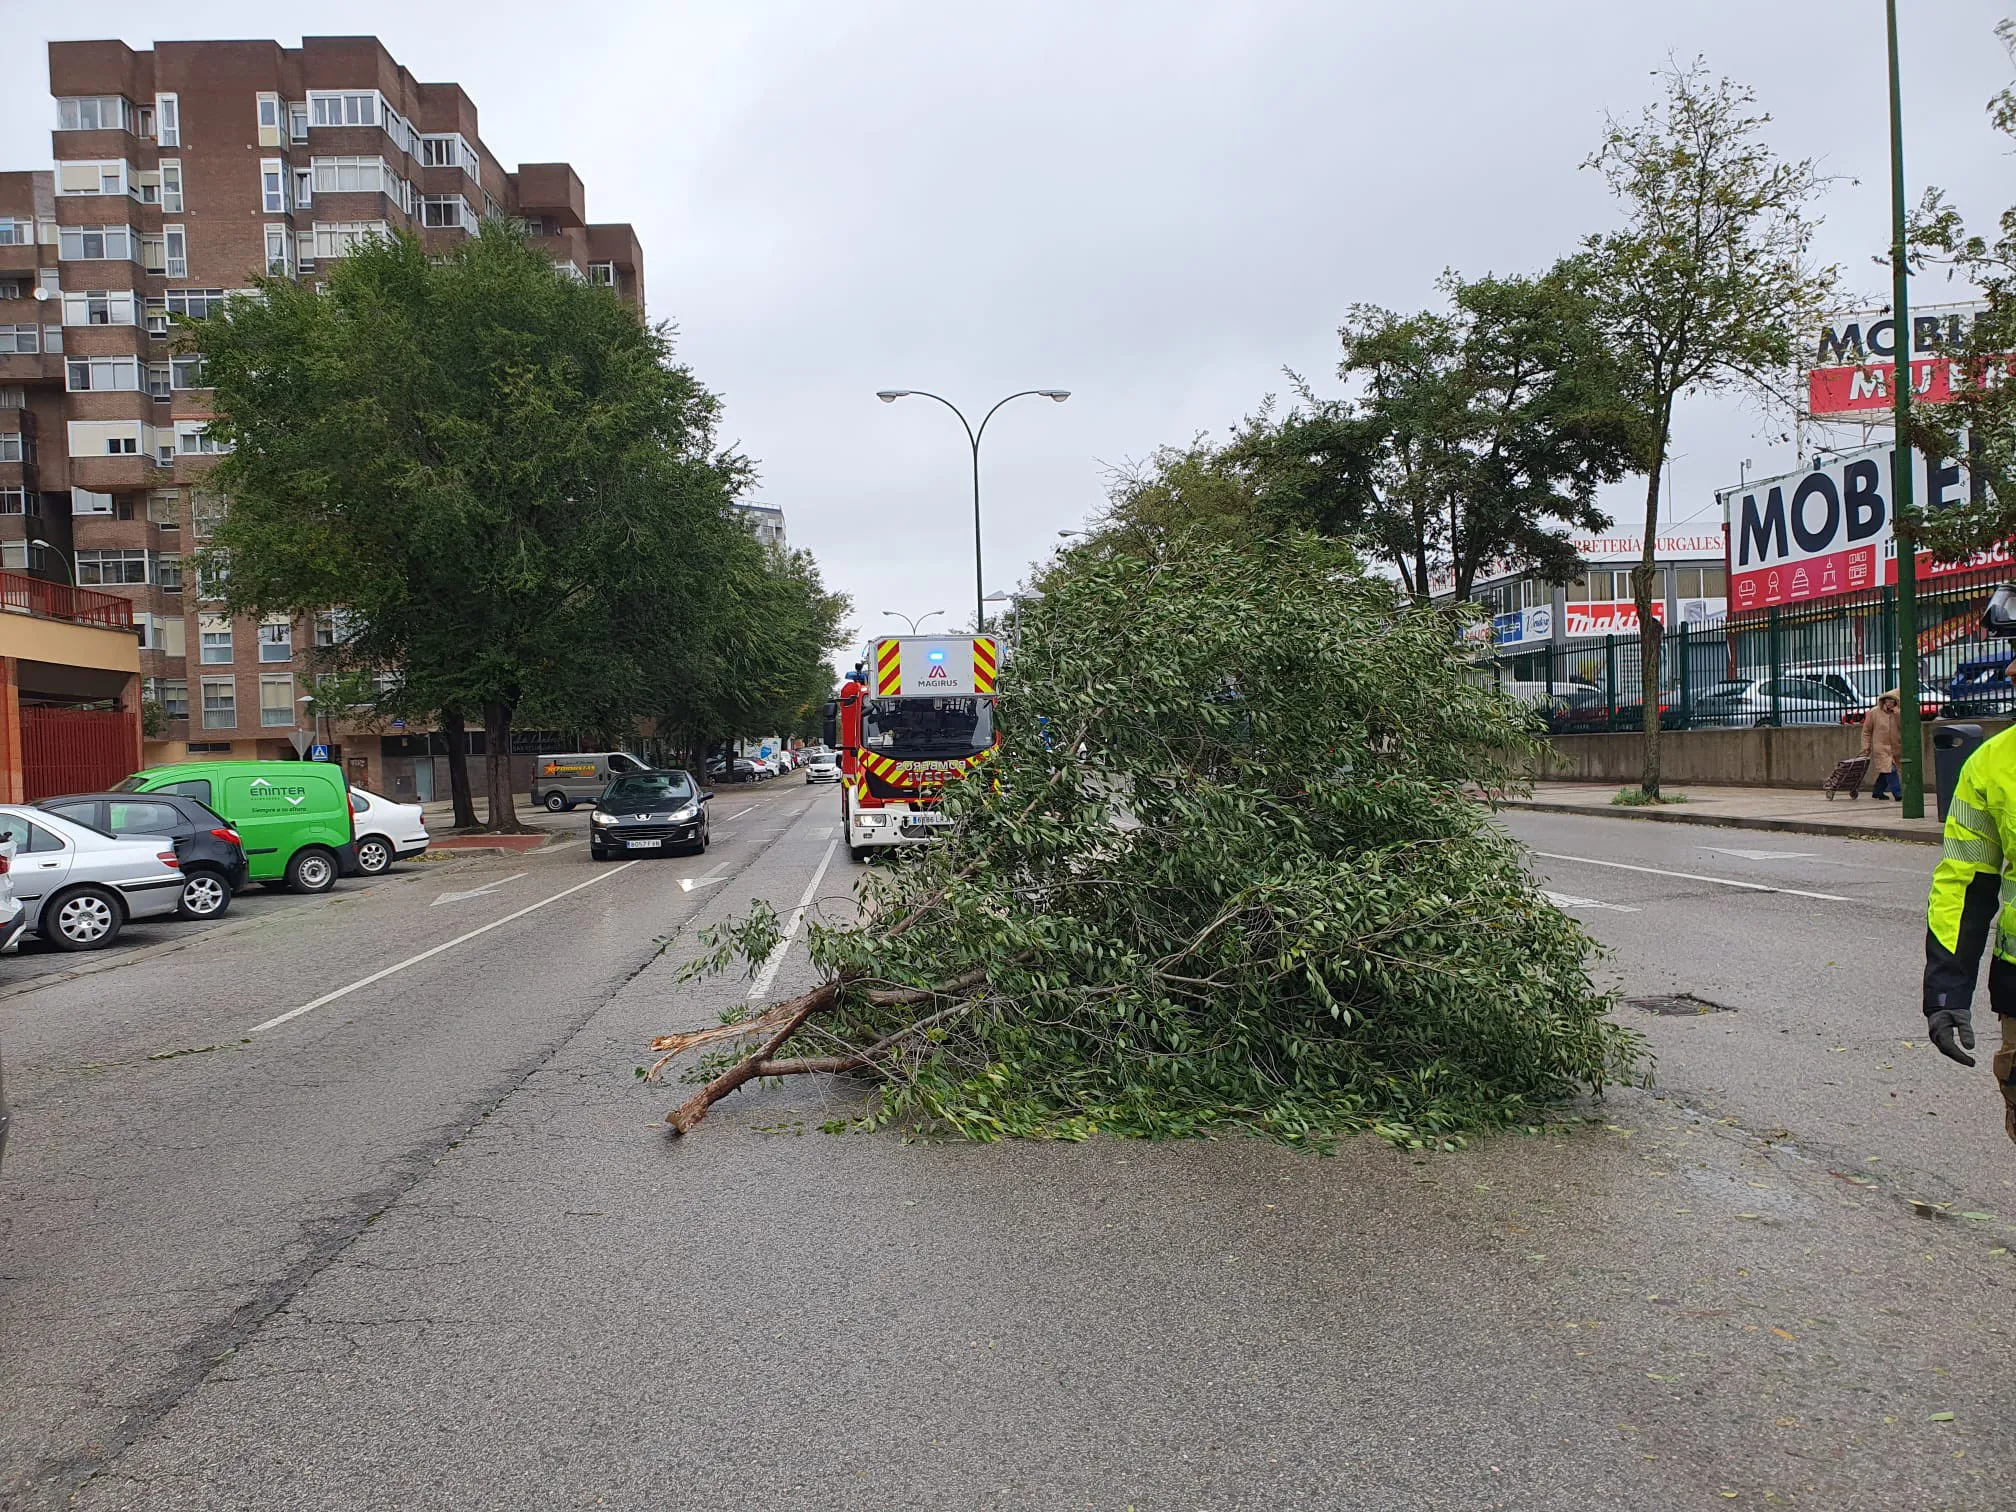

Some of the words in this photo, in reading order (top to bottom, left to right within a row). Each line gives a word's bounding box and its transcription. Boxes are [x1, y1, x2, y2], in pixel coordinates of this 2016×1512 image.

[917, 679, 958, 688] MAGIRUS
[908, 771, 953, 782] IVECO
[250, 786, 306, 796] ENINTER
